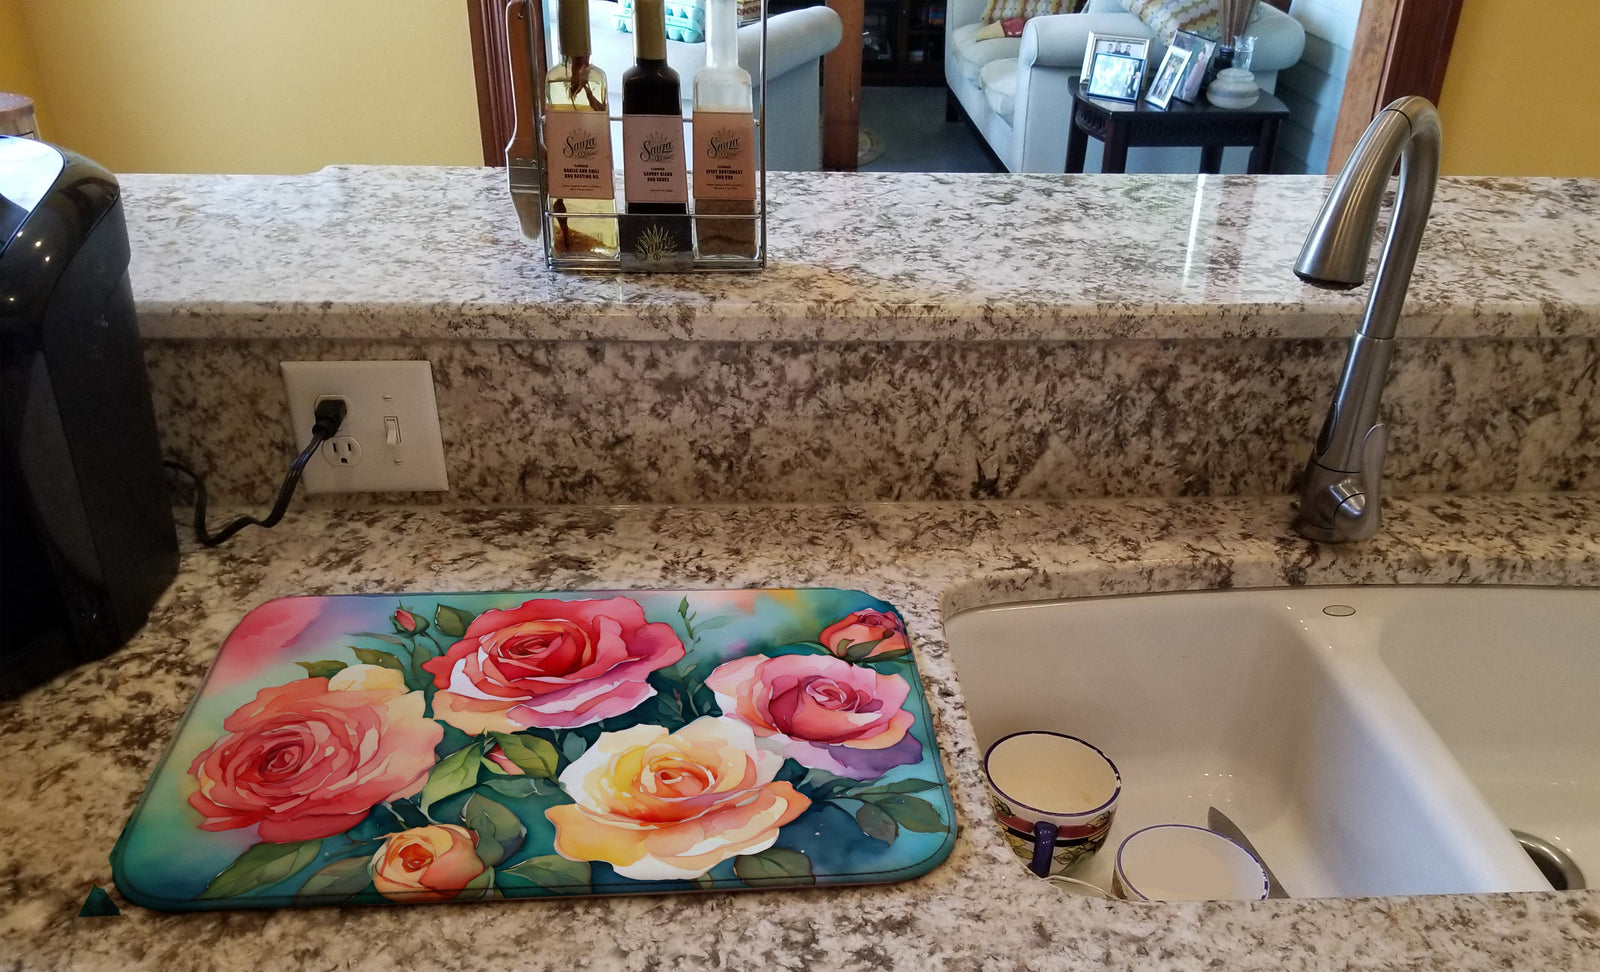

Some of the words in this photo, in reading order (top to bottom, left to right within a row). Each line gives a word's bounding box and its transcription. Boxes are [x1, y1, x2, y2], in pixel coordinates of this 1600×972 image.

[562, 136, 598, 158] Sauza
[640, 140, 674, 162] Sauza
[706, 136, 741, 159] Sauza
